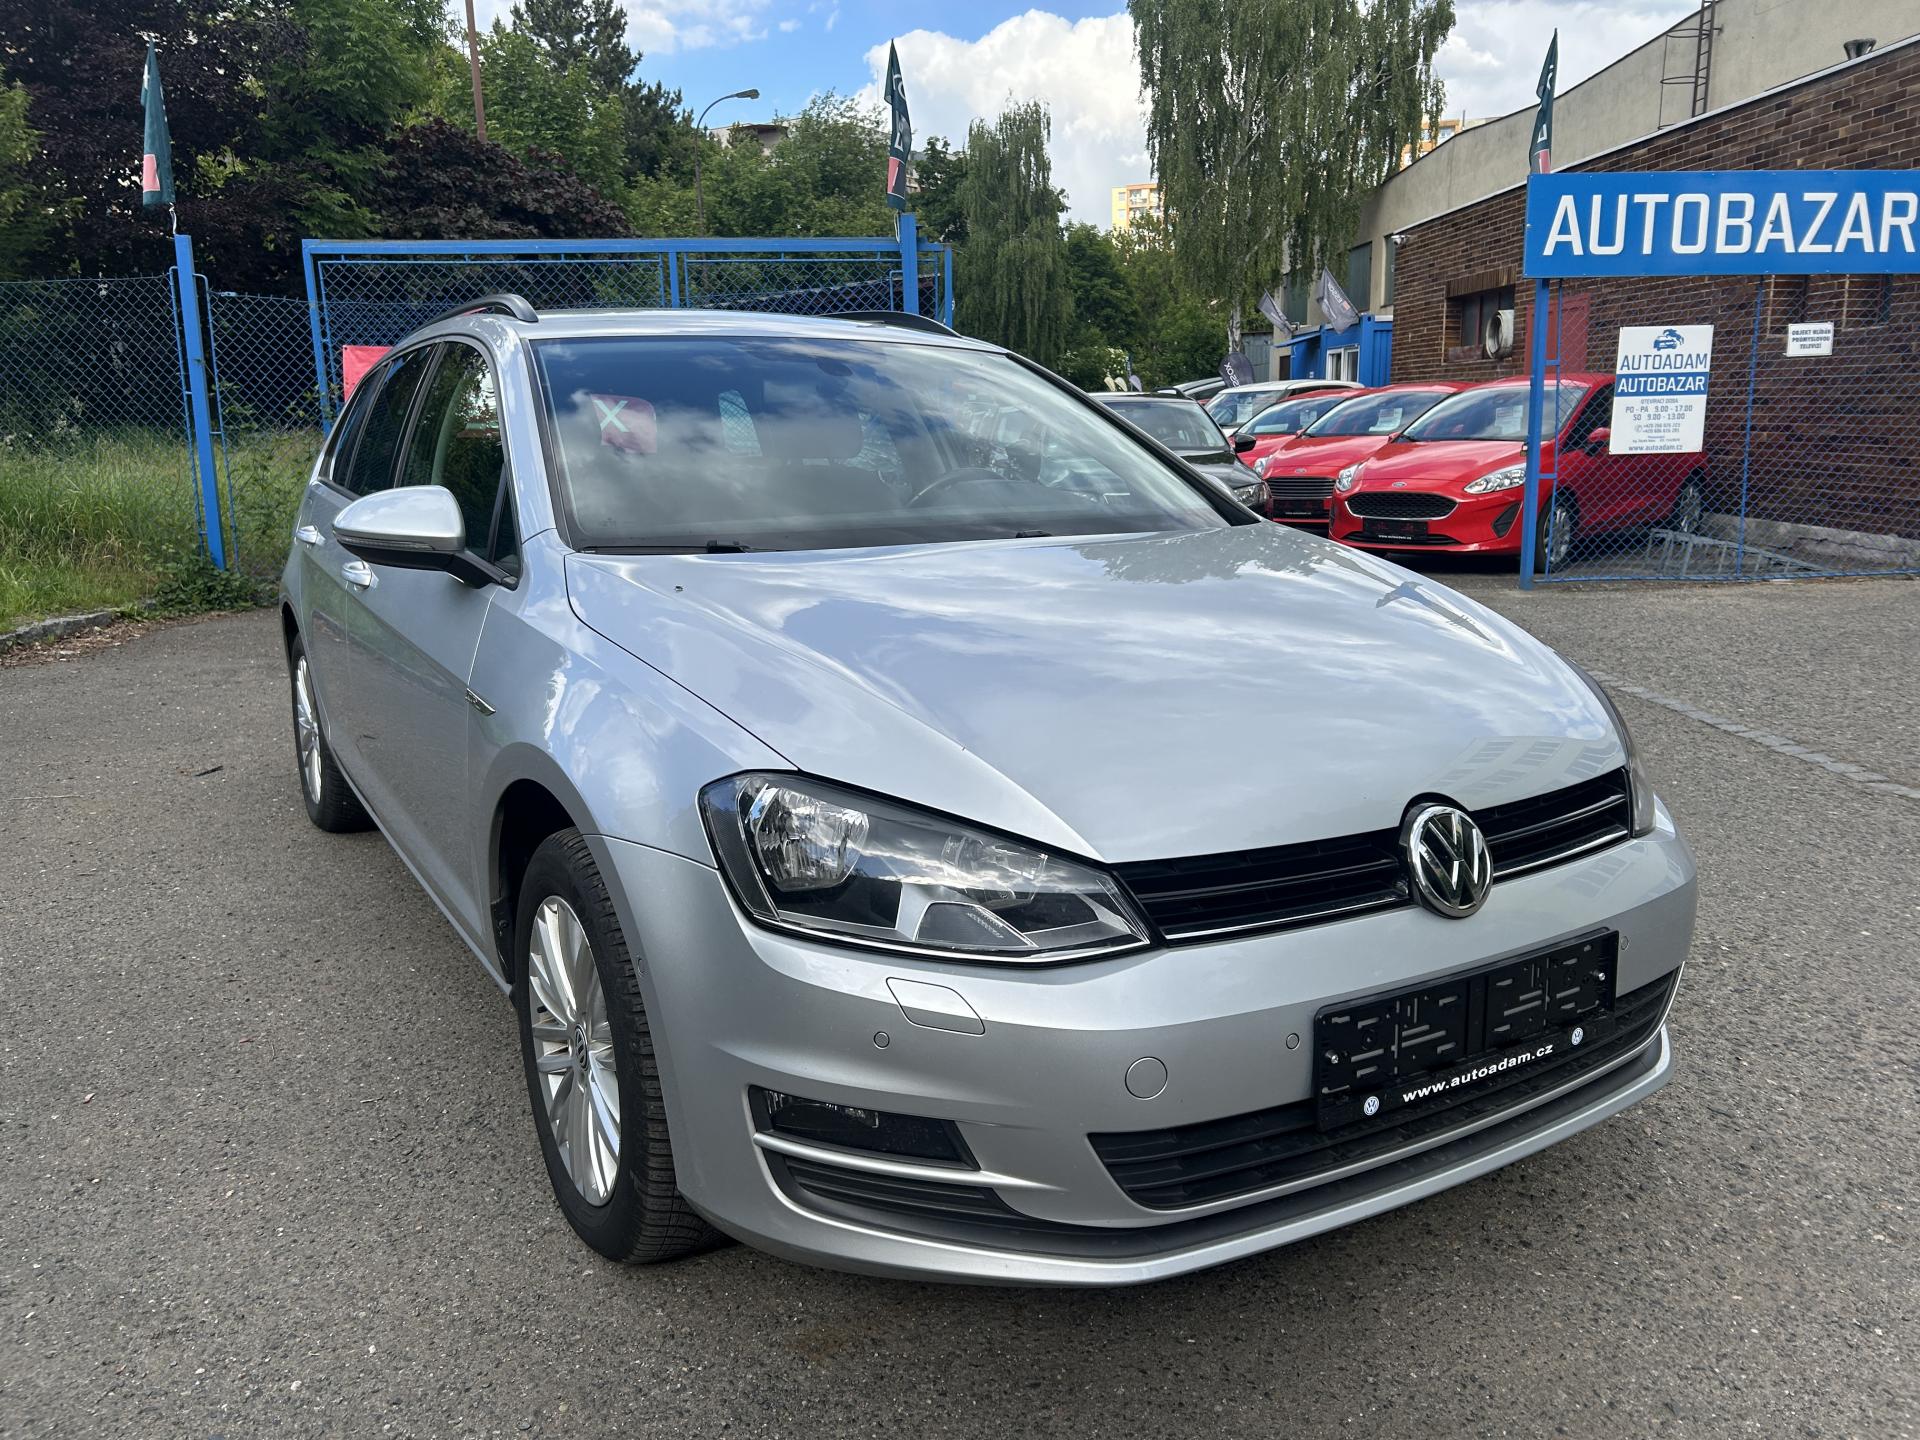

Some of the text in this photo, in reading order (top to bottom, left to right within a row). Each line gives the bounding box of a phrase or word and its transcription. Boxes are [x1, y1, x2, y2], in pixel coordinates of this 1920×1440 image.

[1543, 192, 1918, 256] AUTOBAZAR
[1620, 353, 1708, 371] AUTOADAM
[1617, 376, 1705, 393] AUTOBAZAR
[1402, 1044, 1555, 1104] www.autoadam.cz
